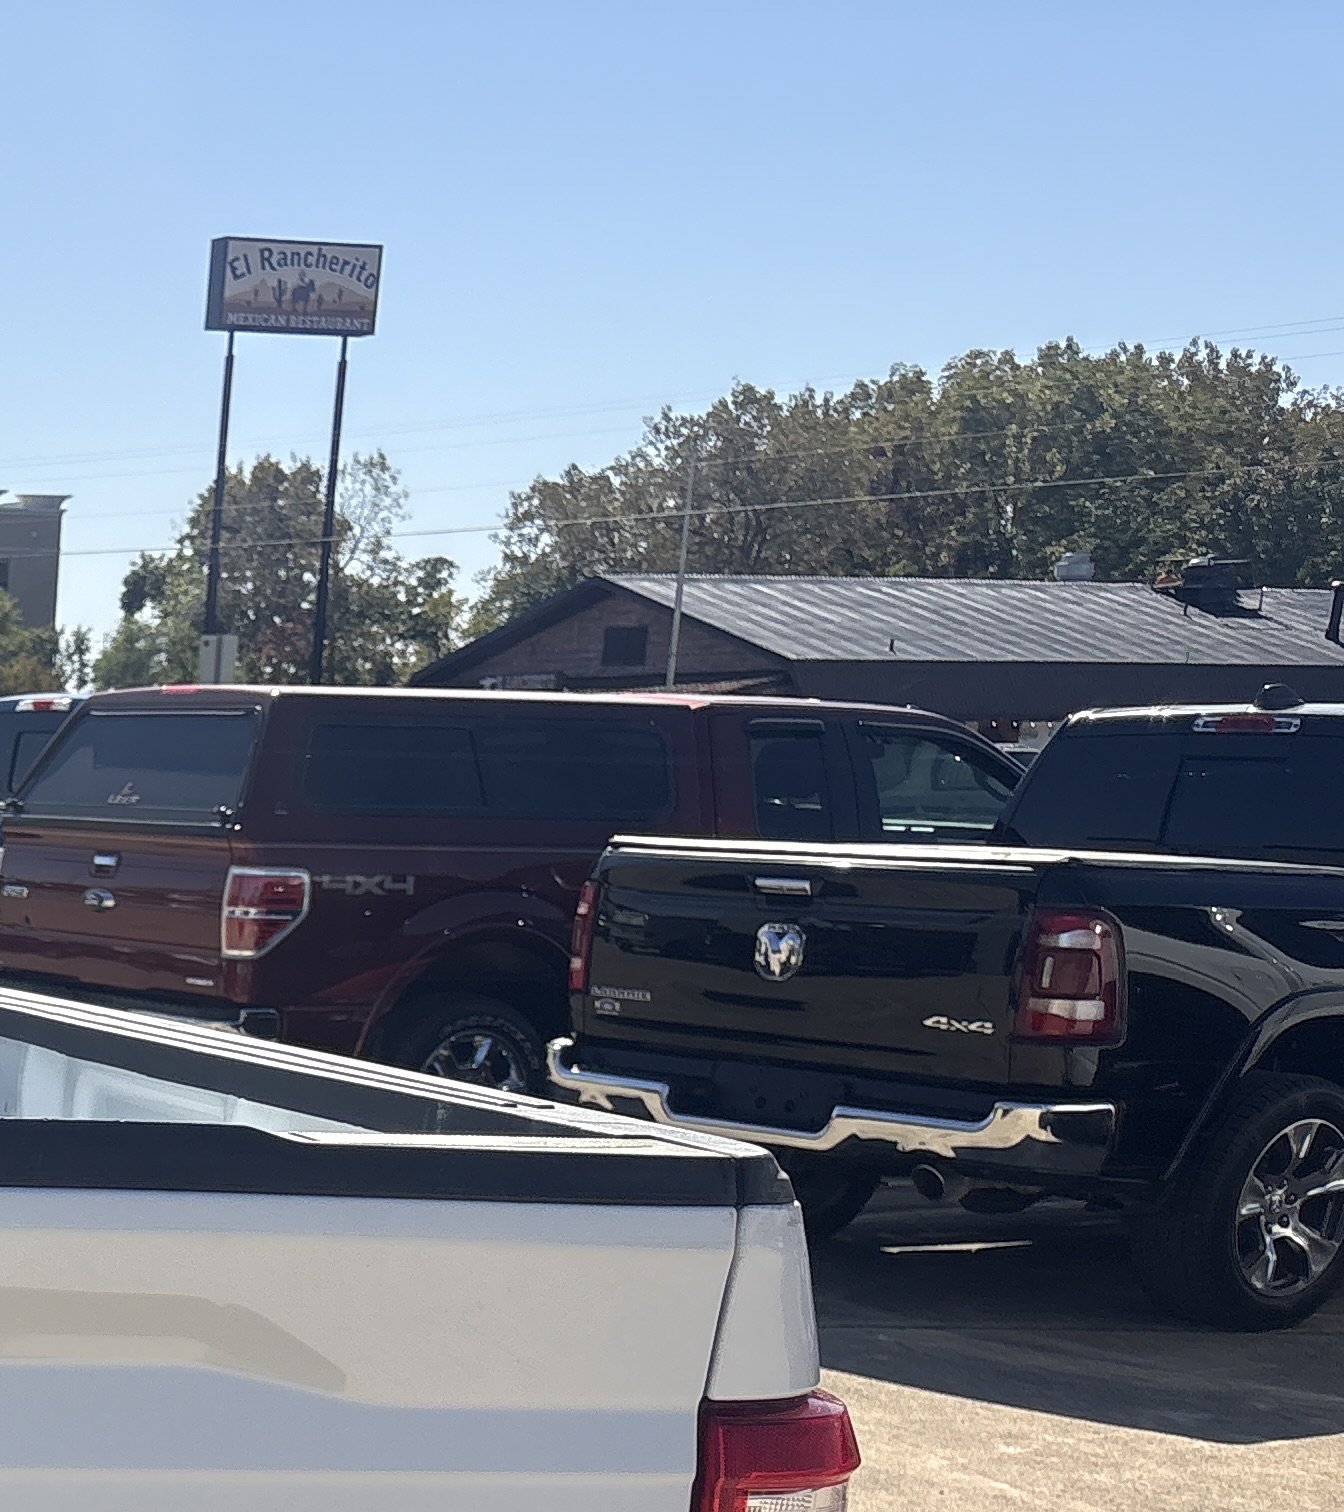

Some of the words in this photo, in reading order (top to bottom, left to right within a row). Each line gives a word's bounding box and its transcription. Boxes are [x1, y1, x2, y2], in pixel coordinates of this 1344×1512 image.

[228, 253, 252, 282] El
[258, 247, 377, 290] Rancherito
[225, 311, 286, 328] MEXICAN
[288, 315, 370, 331] RESTAURANT
